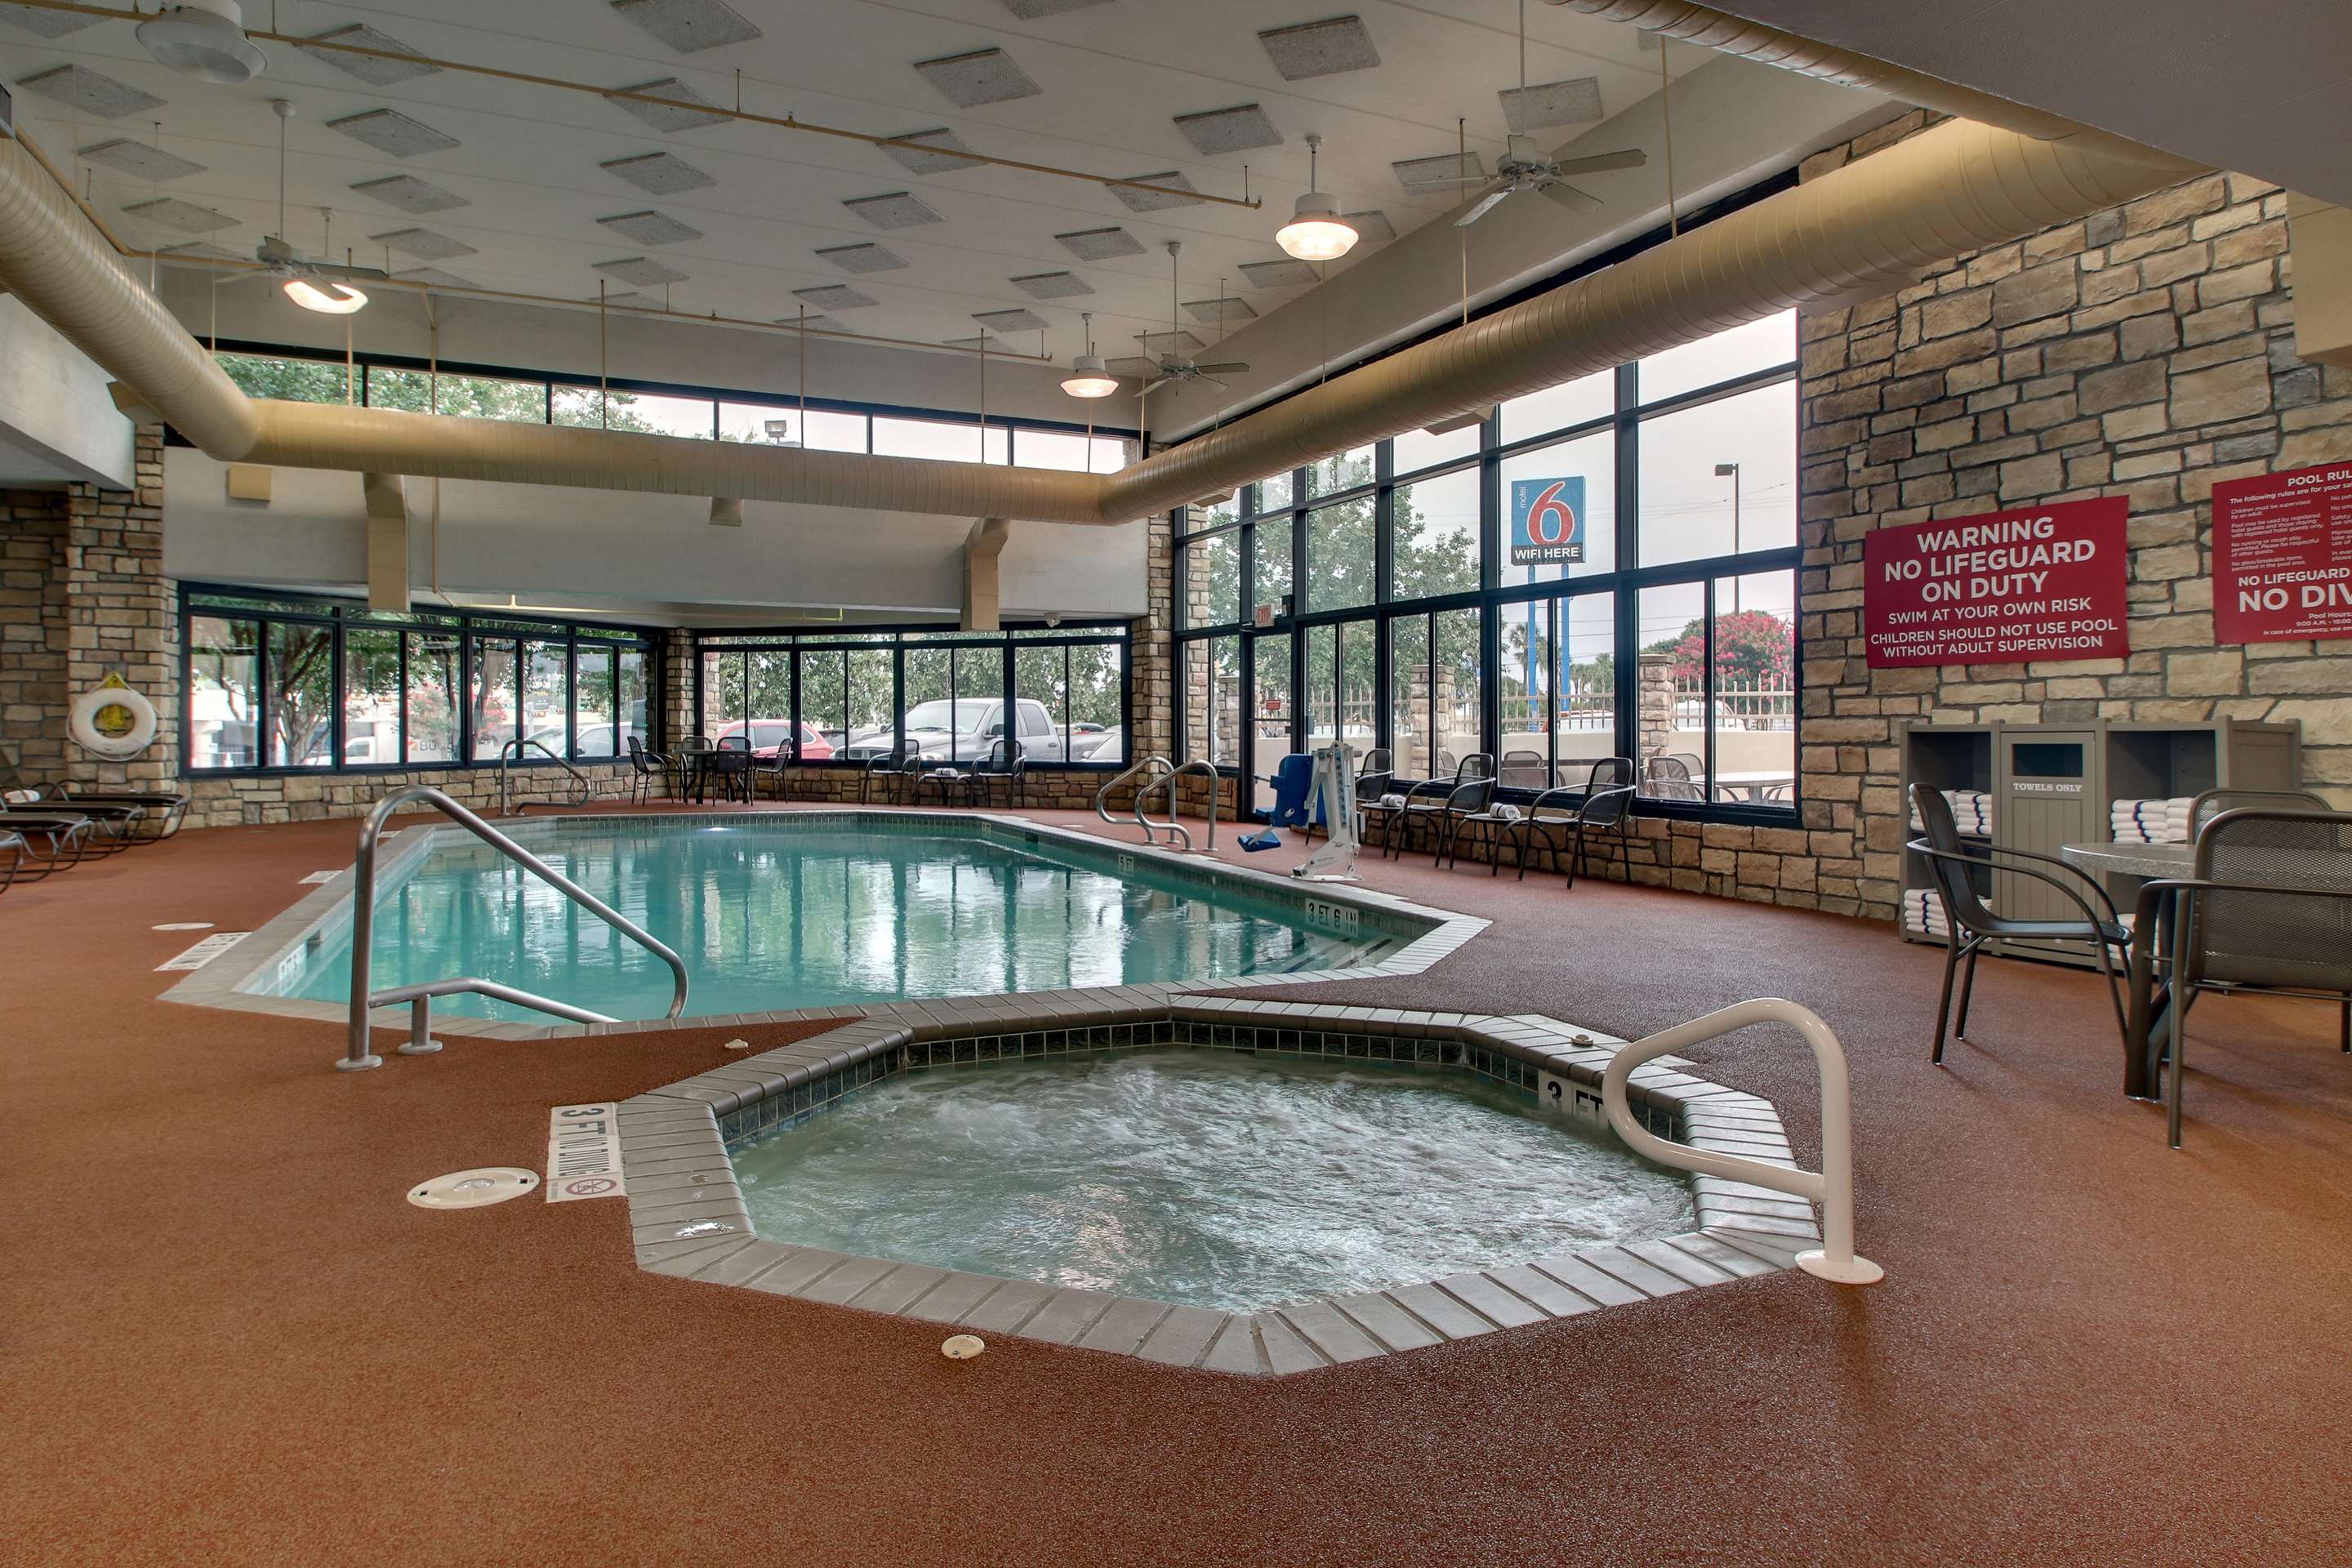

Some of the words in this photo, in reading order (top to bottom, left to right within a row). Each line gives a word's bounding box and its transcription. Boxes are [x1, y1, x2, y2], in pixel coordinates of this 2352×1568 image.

[2287, 474, 2323, 487] POOL
[2244, 492, 2276, 502] following
[1527, 481, 1575, 546] 6
[1917, 517, 2055, 554] WARNING
[1515, 548, 1541, 559] WIFI
[1544, 547, 1579, 558] HERE
[1884, 559, 1921, 582] NO
[1930, 539, 2096, 577] LIFEGUARD
[1922, 579, 1960, 603] ON
[1971, 571, 2049, 599] DUTY
[2238, 576, 2260, 587] NO
[2264, 568, 2350, 584] LIFEGUARD
[1888, 610, 1927, 625] SWIM
[1932, 608, 1950, 621] AT
[1954, 605, 1998, 620] YOUR
[2004, 600, 2045, 615] OWN
[2051, 597, 2092, 612] RISK
[2239, 588, 2289, 612] NO
[1870, 630, 1935, 644] CHILDREN
[1939, 626, 1996, 641] SHOULD
[2000, 624, 2031, 637] NOT
[2036, 621, 2067, 635] USE
[2071, 618, 2118, 633] POOL
[1883, 644, 1943, 658] WITHOUT
[1948, 641, 1993, 654] ADULT
[1998, 635, 2103, 653] SUPERVISION
[2013, 782, 2053, 792] TOWELS
[2056, 784, 2082, 793] ONLY
[560, 1108, 605, 1118] 3
[559, 1121, 606, 1136] FT
[559, 1136, 607, 1149] NO
[559, 1149, 610, 1177] DIVING
